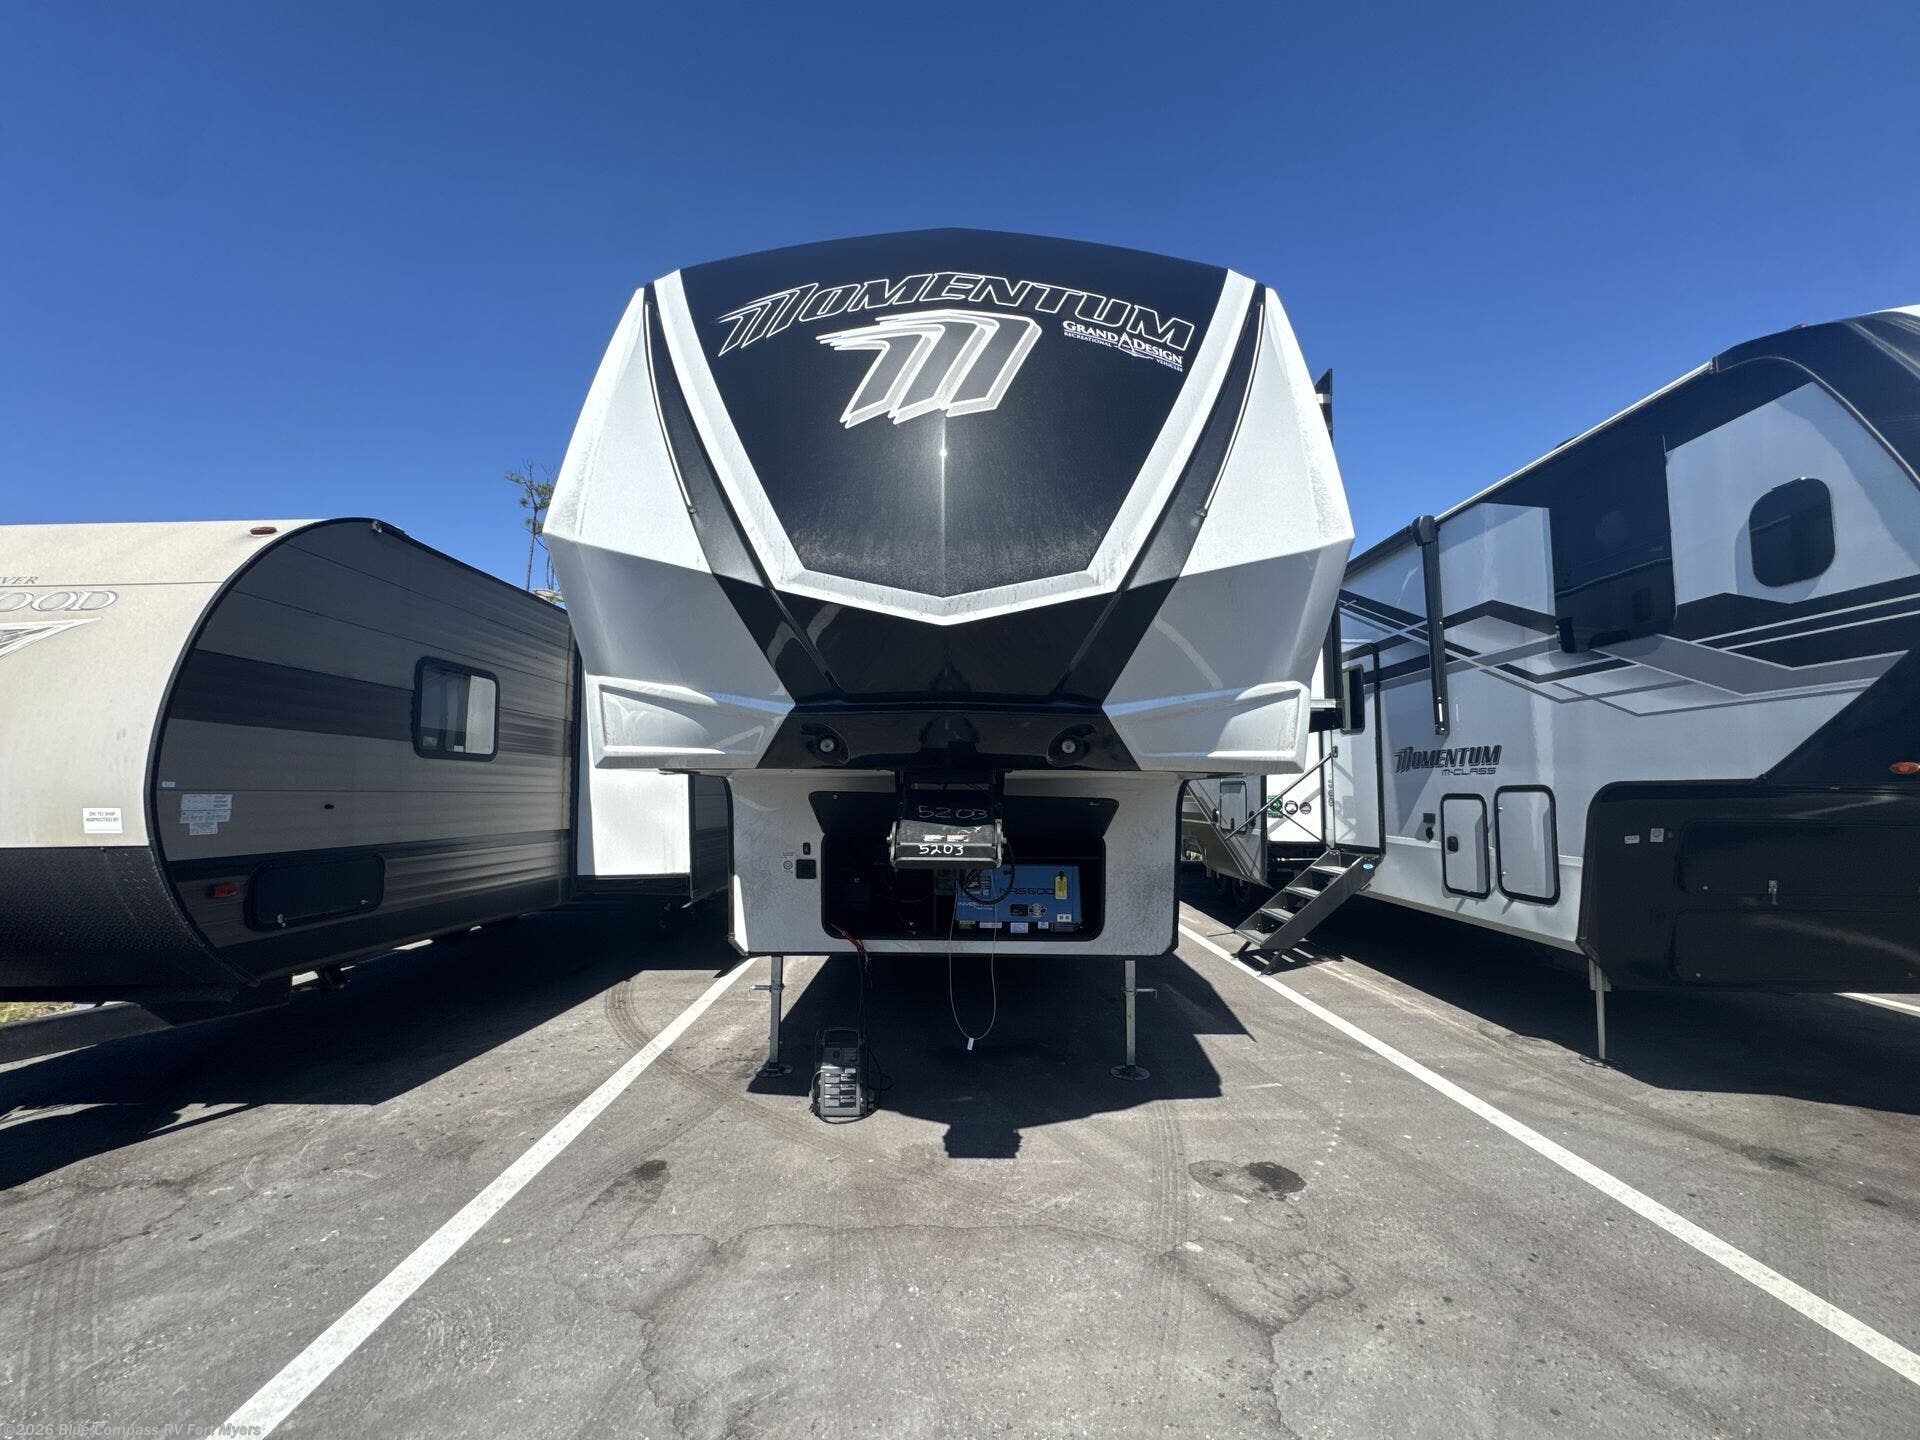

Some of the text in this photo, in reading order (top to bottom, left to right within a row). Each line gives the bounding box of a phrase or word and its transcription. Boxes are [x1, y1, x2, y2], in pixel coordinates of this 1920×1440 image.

[717, 271, 1195, 357] MOMENTUM
[1062, 320, 1183, 365] GRAND DESIGN
[0, 576, 39, 585] VER
[1392, 744, 1502, 774] MOMENTUM
[918, 805, 988, 820] 5203
[918, 844, 964, 856] 5203
